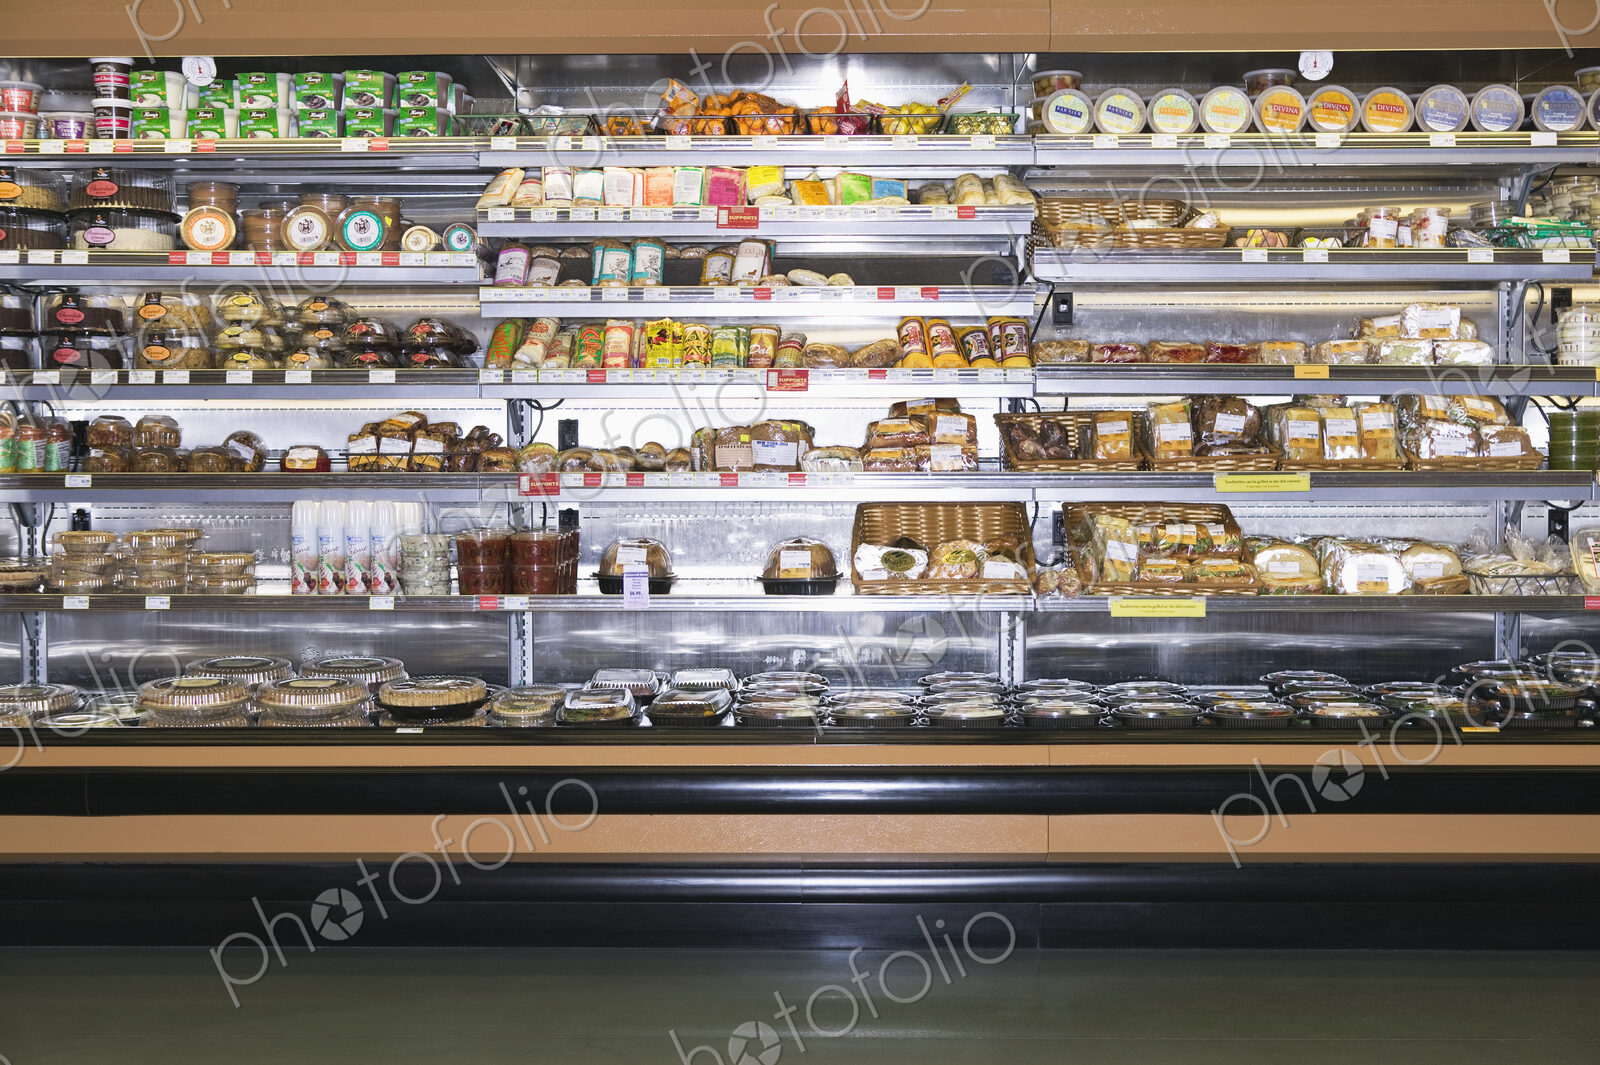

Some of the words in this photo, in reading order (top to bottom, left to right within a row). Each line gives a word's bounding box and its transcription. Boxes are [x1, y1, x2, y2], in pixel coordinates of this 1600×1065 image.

[1272, 104, 1299, 115] DIVINA
[1322, 102, 1350, 112] DIVINA
[1377, 104, 1404, 113] DIVINA
